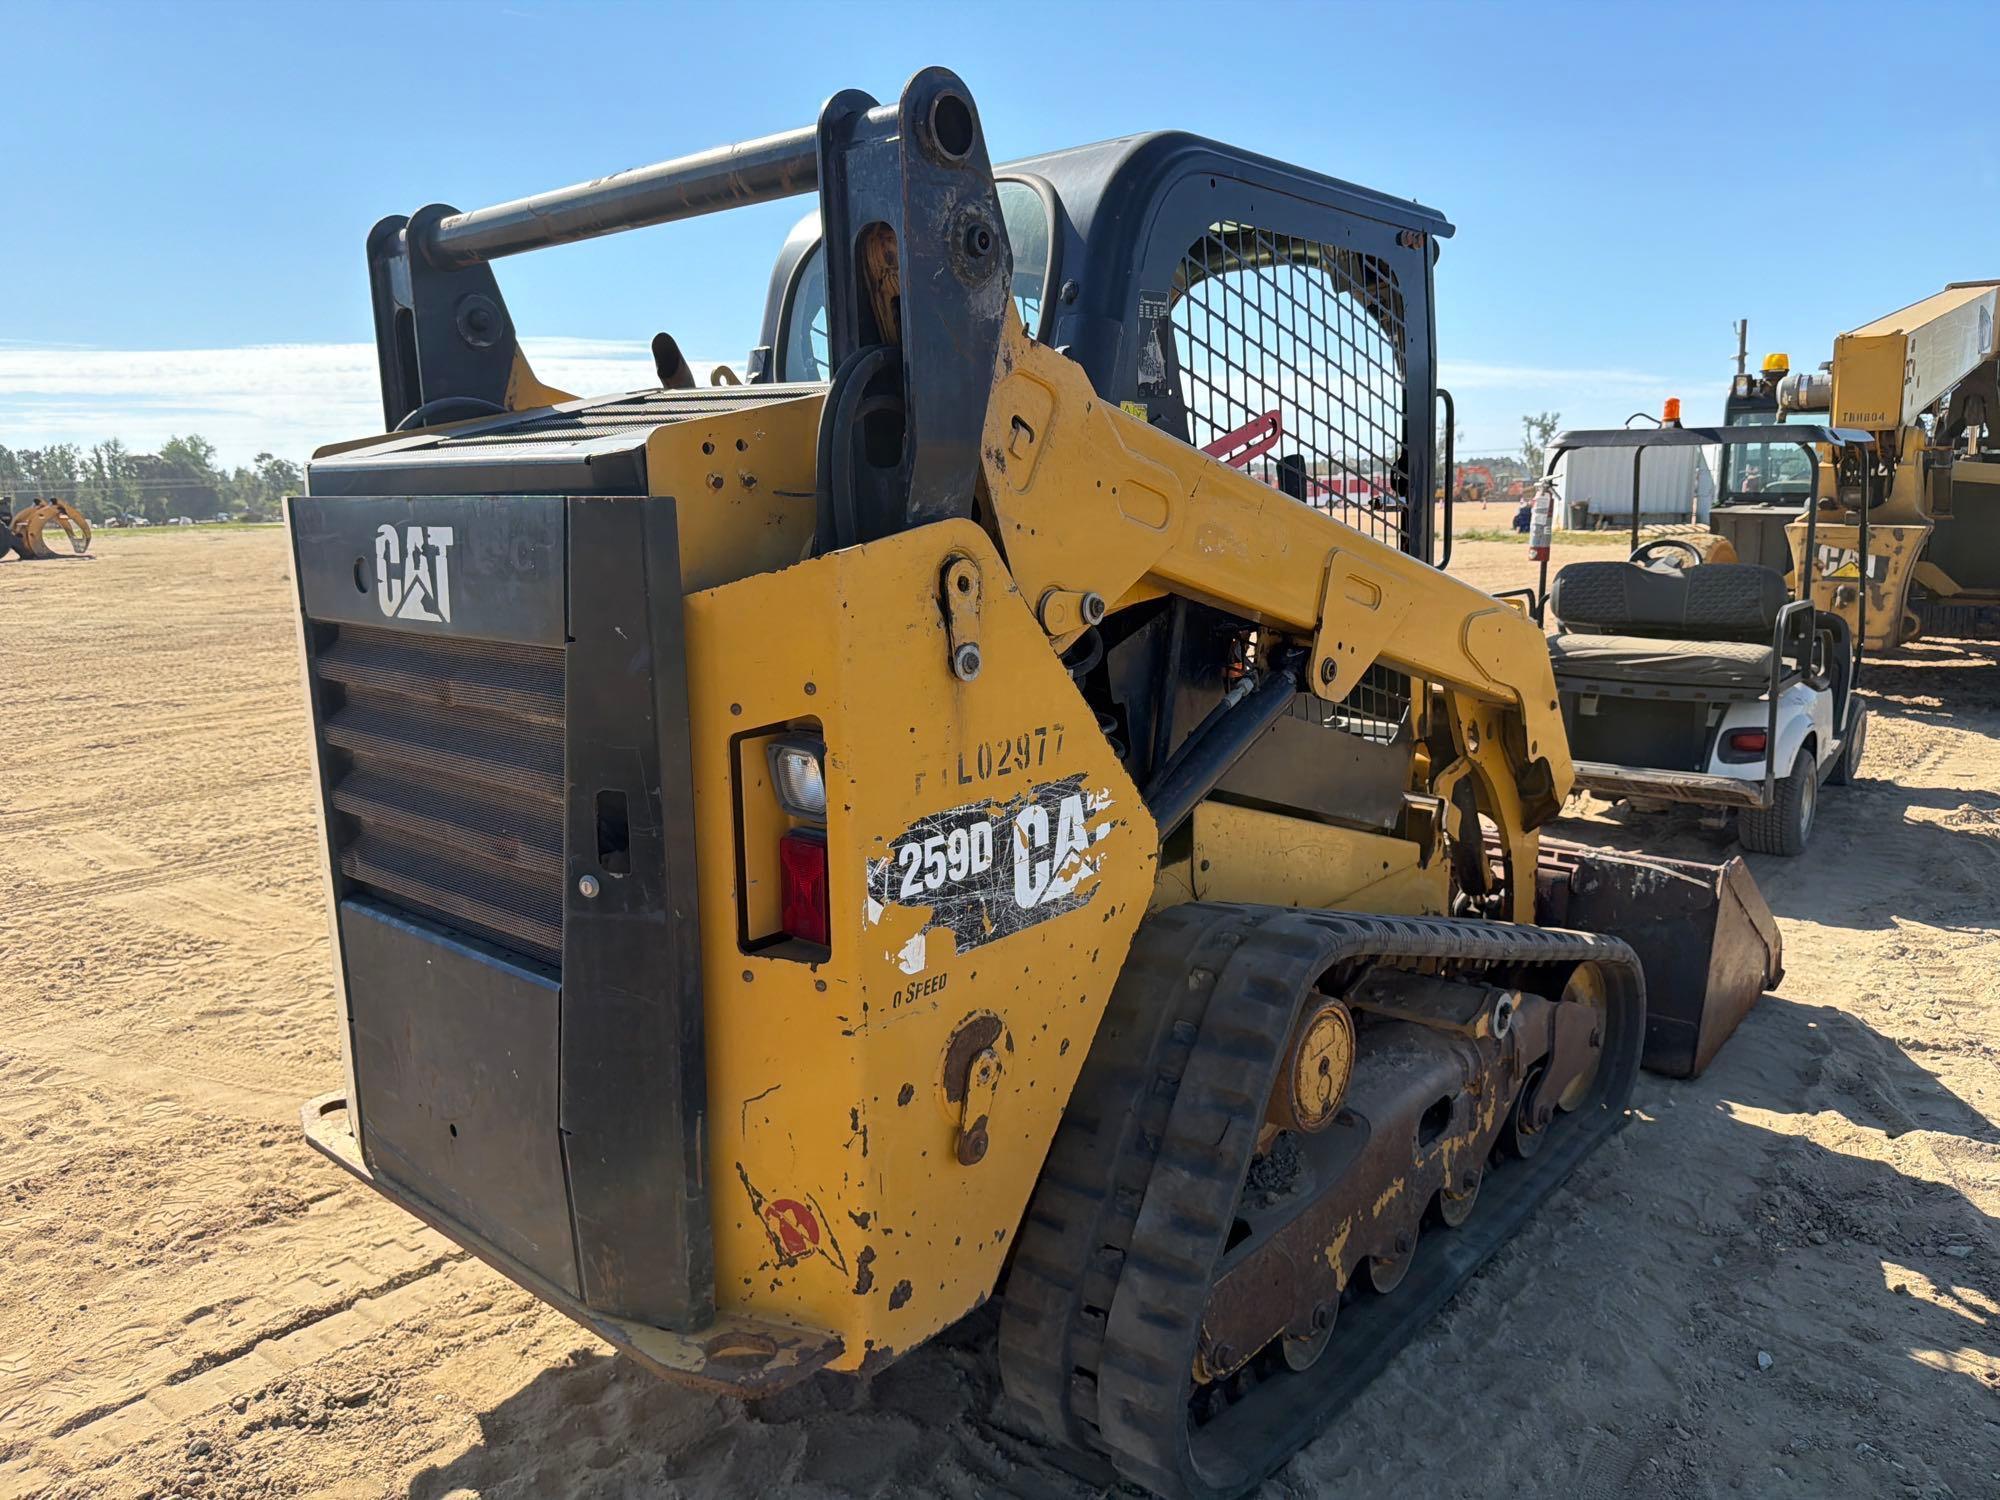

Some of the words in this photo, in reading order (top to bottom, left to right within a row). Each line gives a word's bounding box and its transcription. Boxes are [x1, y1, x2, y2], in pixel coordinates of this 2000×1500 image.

[375, 523, 454, 623] CAT
[898, 821, 993, 899] 259D
[905, 972, 947, 1004] SPEED
